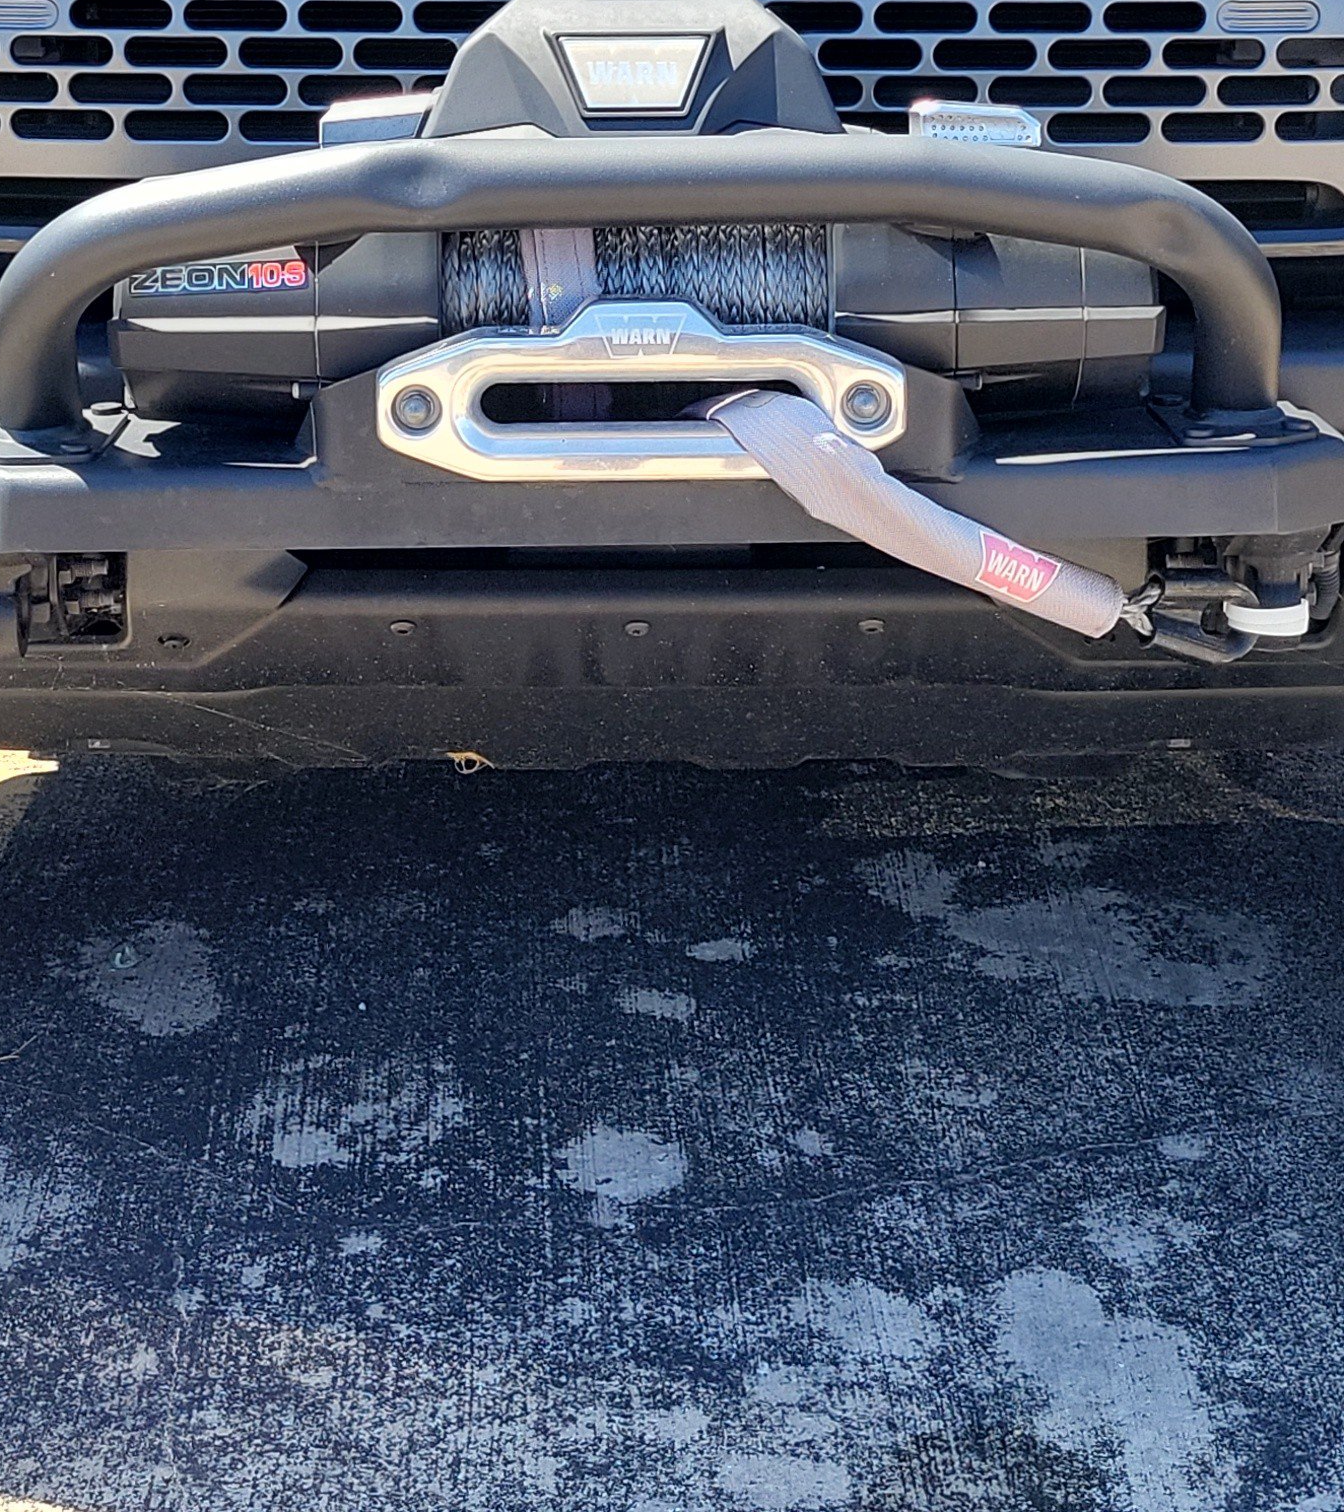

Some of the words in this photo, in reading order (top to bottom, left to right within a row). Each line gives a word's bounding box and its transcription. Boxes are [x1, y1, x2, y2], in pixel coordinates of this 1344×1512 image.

[586, 61, 678, 85] WARN
[611, 328, 671, 345] WARN
[987, 549, 1045, 592] WARN
